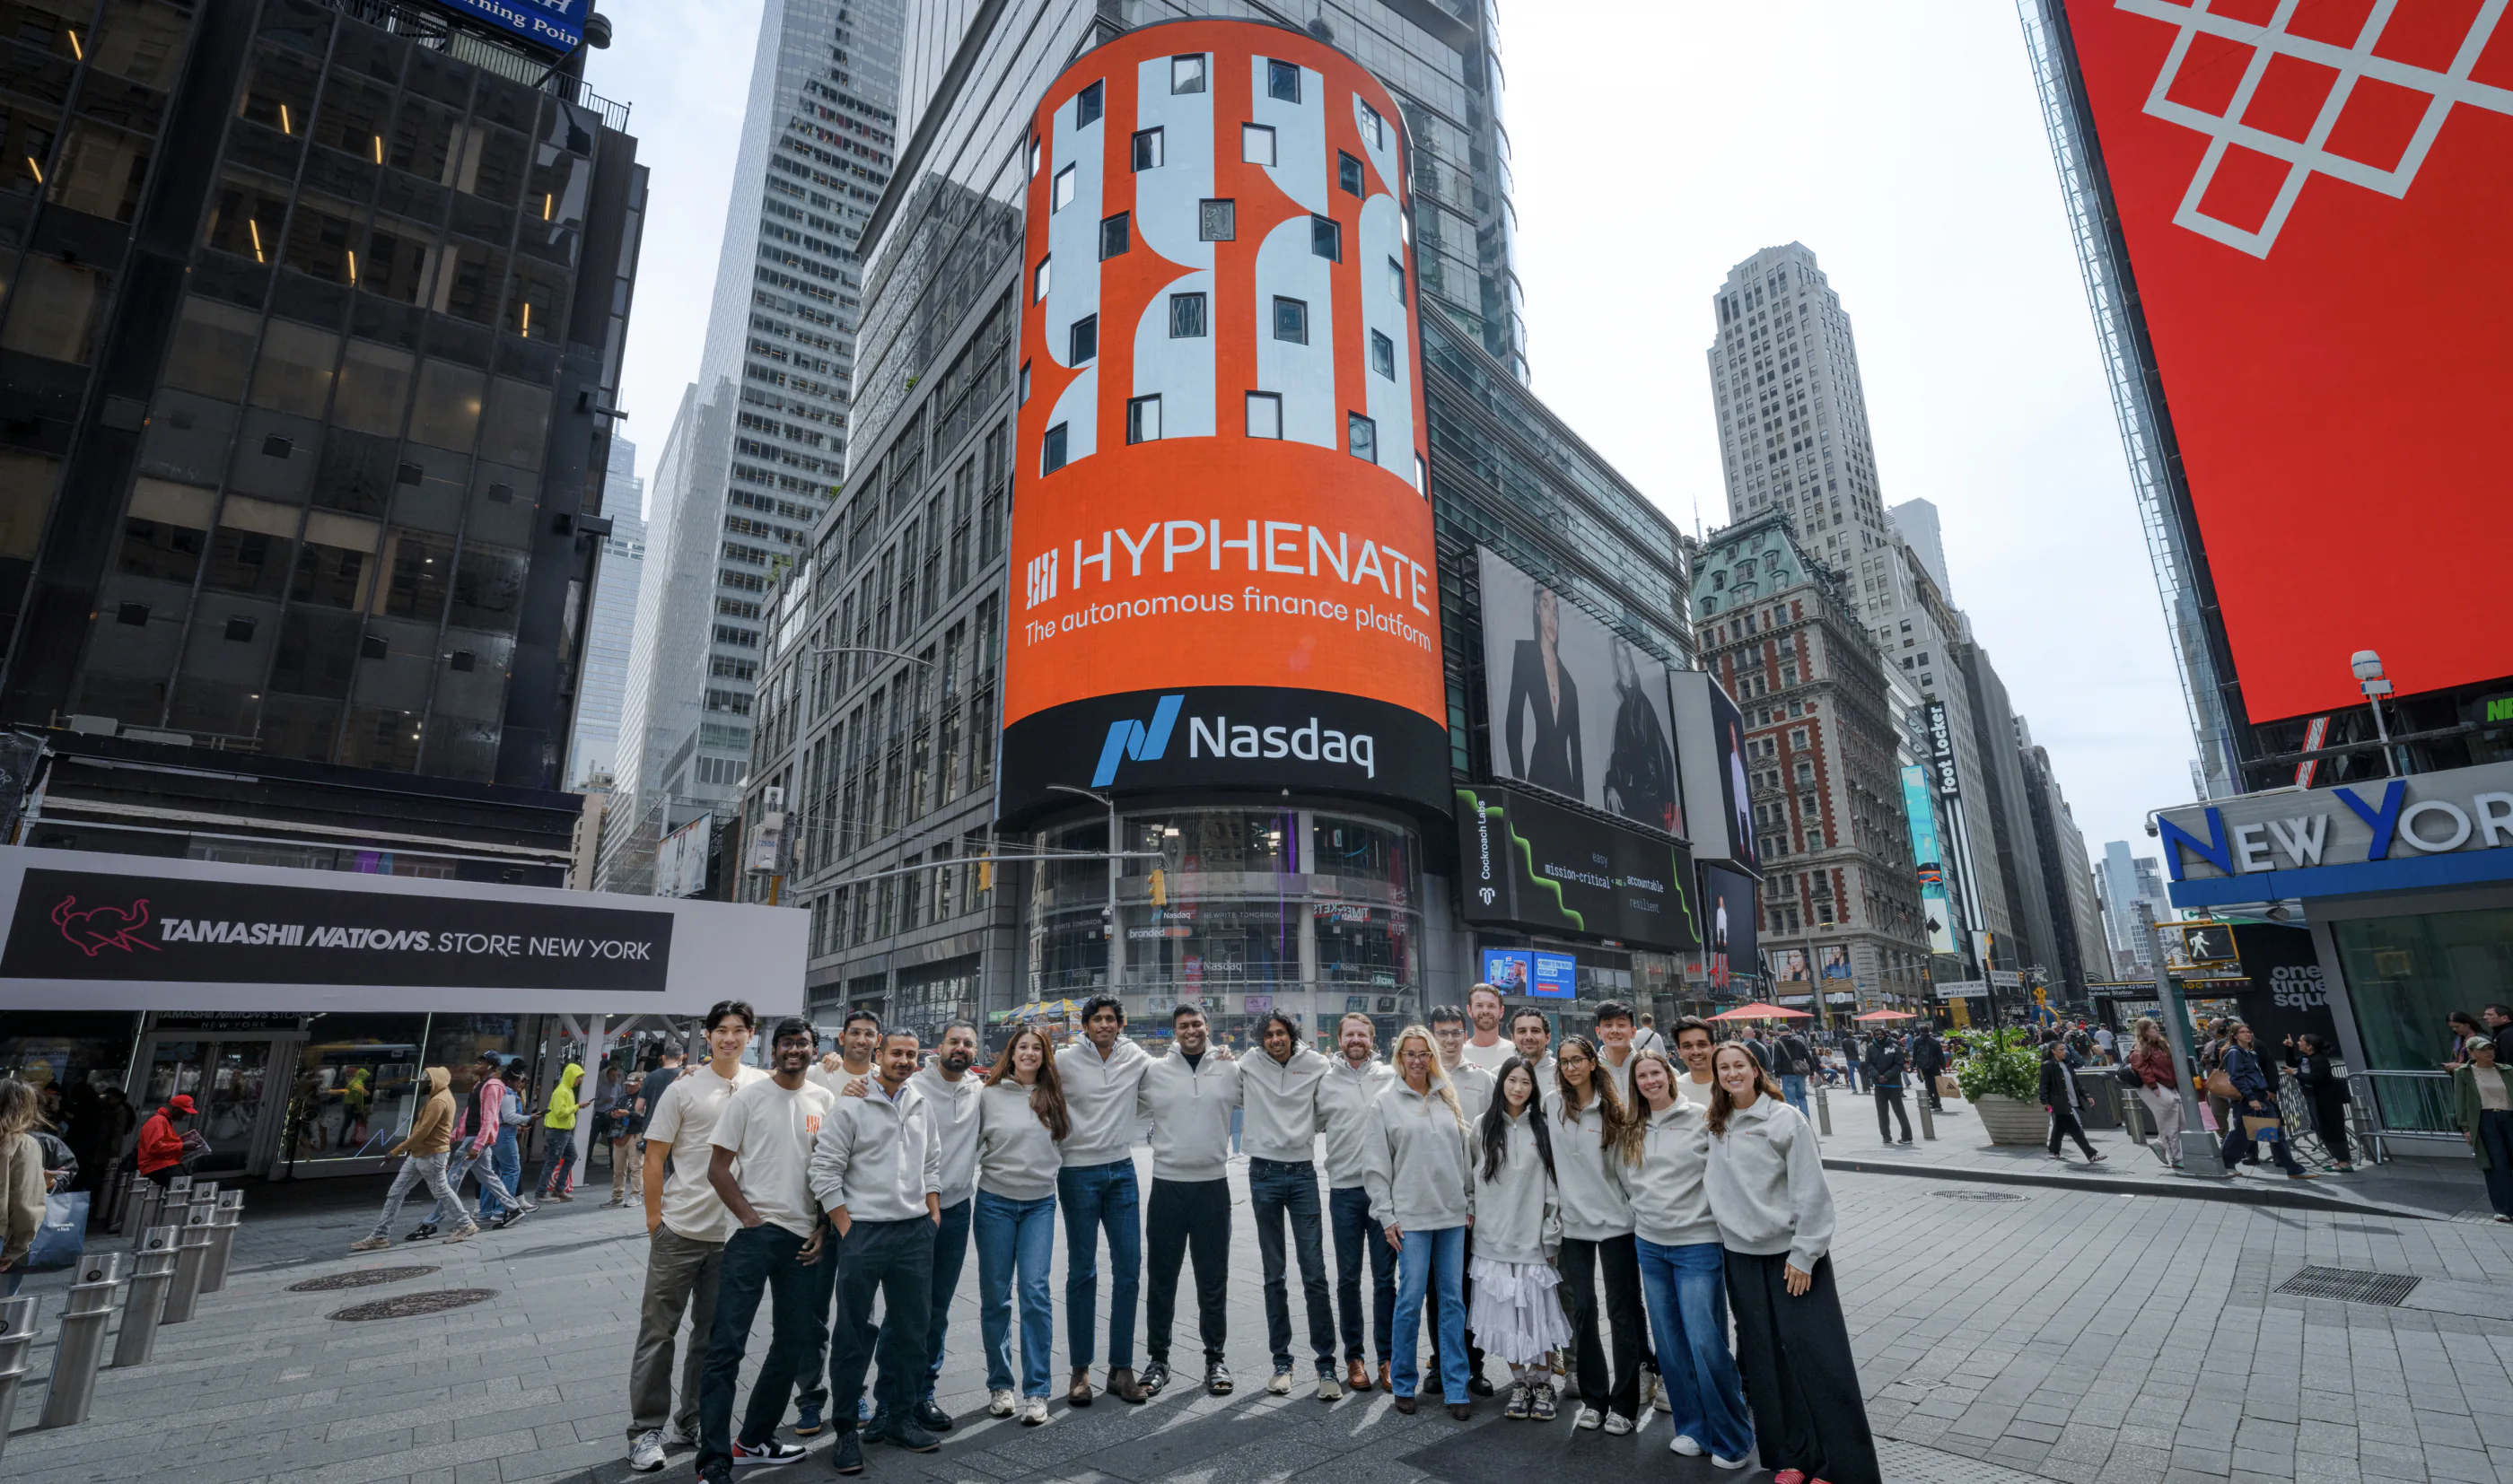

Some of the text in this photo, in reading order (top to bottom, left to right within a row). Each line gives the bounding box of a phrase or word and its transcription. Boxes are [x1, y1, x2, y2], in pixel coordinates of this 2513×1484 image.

[1073, 519, 1430, 616] HYPHENATE
[1026, 586, 1432, 653] The autonomous finance platform
[1190, 716, 1375, 779] Nasdaq
[1938, 759, 1957, 793] Foot
[1477, 799, 1491, 880] Cockroach Labs
[2156, 779, 2513, 881] NEW YOR
[1592, 852, 1608, 868] easy
[1545, 863, 1611, 889] mission-critical
[1627, 875, 1664, 893] accountable
[1163, 912, 1191, 920] Nasdaq
[1629, 898, 1659, 913] resilient
[160, 918, 305, 947] TAMASHII
[437, 932, 522, 957] STORE
[529, 937, 585, 957] NEW
[588, 939, 652, 960] YORK
[1129, 928, 1166, 938] branded
[1203, 962, 1243, 972] Nasdaq
[2272, 965, 2323, 980] one
[234, 1020, 267, 1028] YORK
